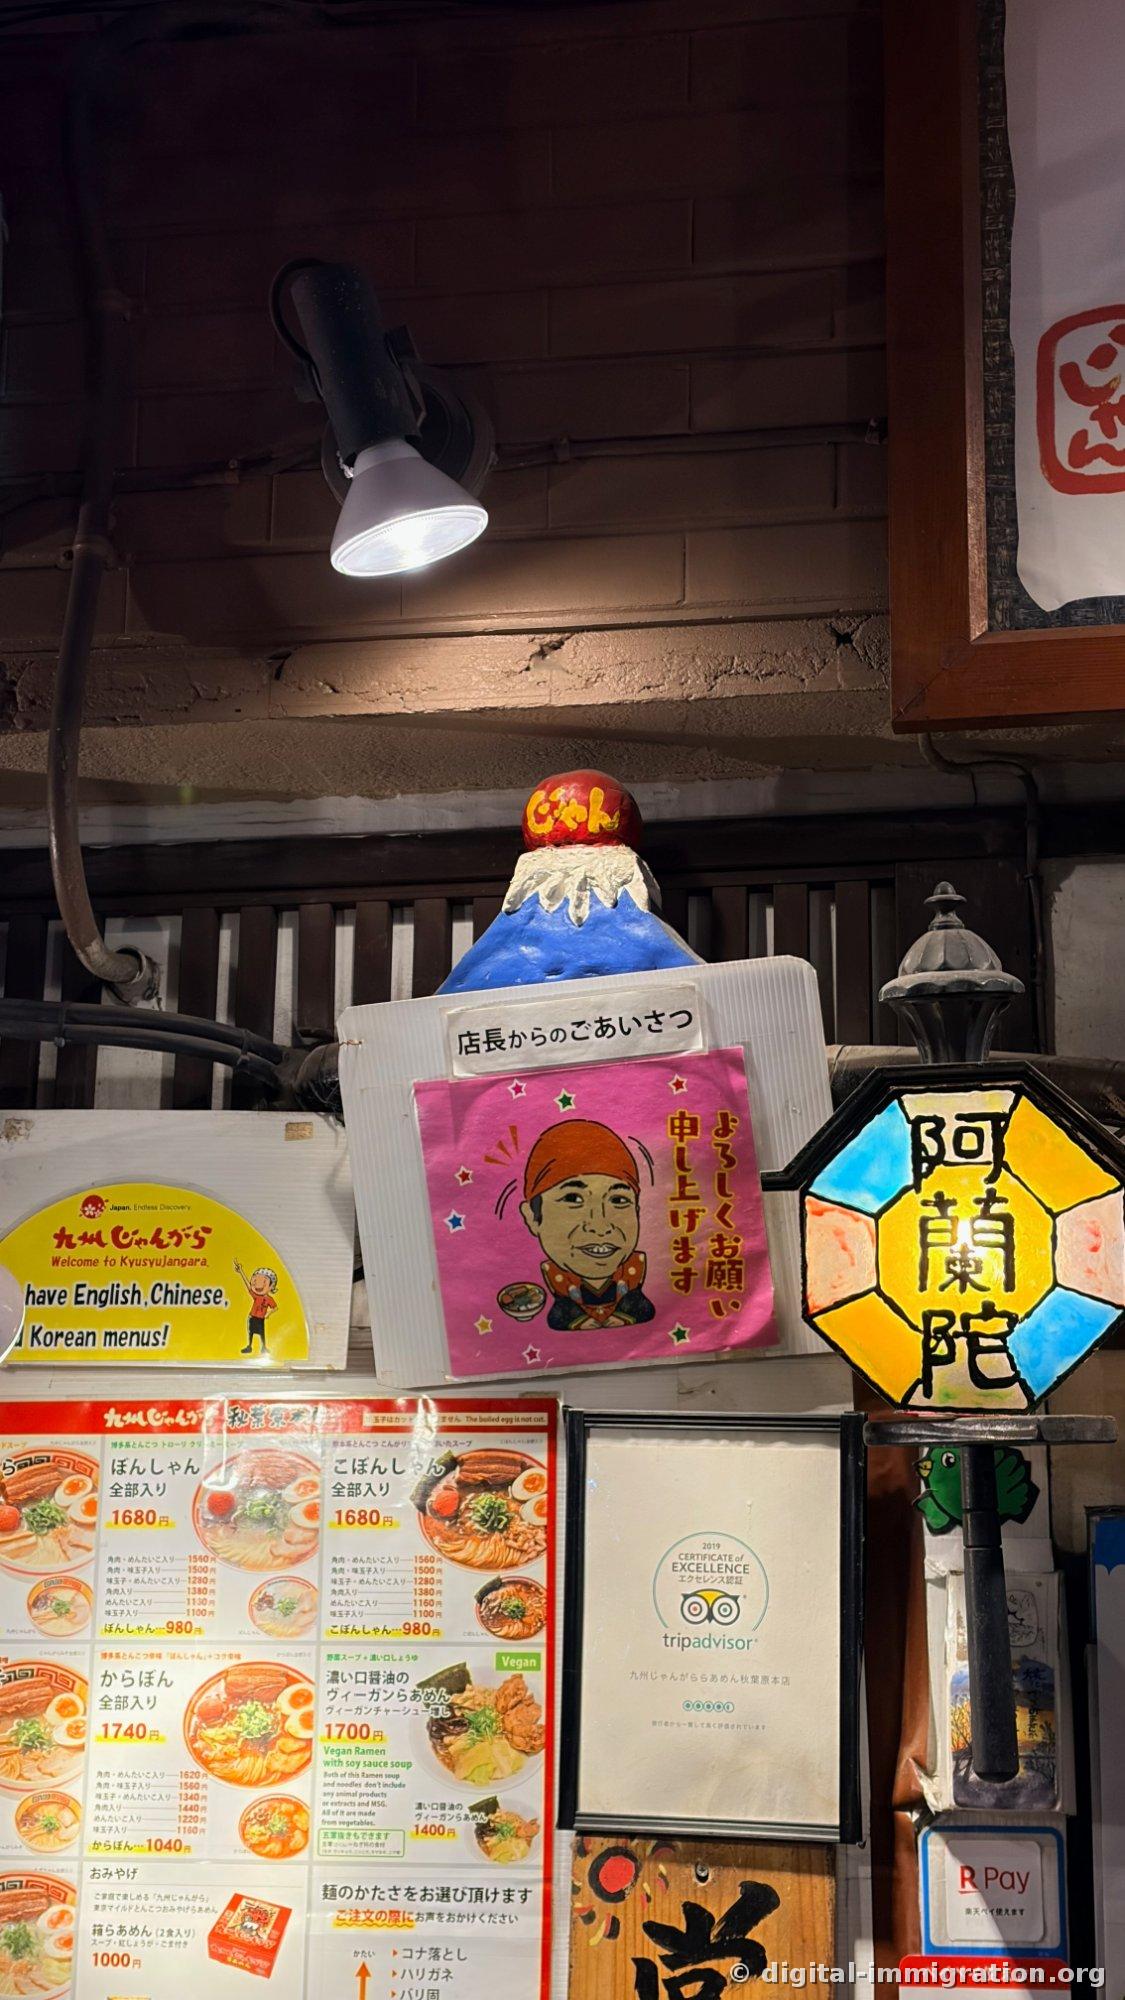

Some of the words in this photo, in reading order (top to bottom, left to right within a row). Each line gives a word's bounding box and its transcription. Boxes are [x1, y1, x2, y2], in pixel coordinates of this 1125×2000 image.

[526, 786, 621, 834] じゃん
[458, 1009, 693, 1055] 店長からのごあいさつ
[110, 1204, 131, 1212] Japan.
[668, 1110, 705, 1294] 申し上げます
[706, 1110, 745, 1319] よろしくお願い
[53, 1225, 213, 1250] 九州じゃんがら
[51, 1255, 99, 1267] Welcome
[104, 1255, 116, 1267] to
[911, 1112, 1021, 1399] 阿蘭陀
[25, 1283, 67, 1306] have
[30, 1325, 96, 1347] Korean
[103, 1325, 170, 1347] menus!
[466, 1415, 477, 1423] The
[501, 1417, 513, 1425] egg
[111, 1458, 200, 1475] ぼんしゃん
[109, 1482, 167, 1498] 全部入り
[331, 1482, 390, 1498] 全部入り
[112, 1510, 169, 1526] 1680円
[335, 1510, 393, 1526] 1680円
[678, 1553, 733, 1562] CERTIFICATE
[735, 1554, 744, 1562] of
[672, 1563, 750, 1574] EXCELLENCE
[678, 1575, 743, 1585] エクセレンス認証
[104, 1623, 155, 1633] ぼんしゃん
[330, 1624, 392, 1635] こぼんしゃん
[663, 1633, 753, 1651] tripadvisor
[501, 1656, 536, 1668] Vegan
[100, 1670, 174, 1688] からぼん
[326, 1671, 409, 1685] 濃い口醤油の
[629, 1671, 790, 1686] 九州じゃんがららあめん秋葉原本店
[99, 1695, 157, 1710] 全部入り
[326, 1688, 450, 1703] ヴィーガンらあめん
[102, 1723, 160, 1740] 1740円
[325, 1723, 383, 1741] 1700円
[324, 1746, 352, 1757] Vegan
[354, 1747, 386, 1755] Ramen
[323, 1758, 343, 1767] with
[345, 1760, 360, 1769] soy
[363, 1760, 389, 1768] sauce
[390, 1761, 413, 1770] soup
[415, 1803, 463, 1811] 濃い口醤油の
[415, 1812, 487, 1822] ヴィーガンらあめん
[414, 1824, 456, 1837] 1400円
[92, 1840, 133, 1851] からぼん
[90, 1867, 138, 1880] おみやげ
[959, 1865, 977, 1889] R
[984, 1867, 1030, 1894] Pay
[322, 1884, 532, 1904] 麺のかたさをお選び頂けます
[965, 1907, 1025, 1916] 楽天ペイ使えます
[92, 1924, 152, 1937] 箱らあめん
[92, 1952, 141, 1968] 1000円
[353, 1950, 375, 1958] かたい
[402, 1948, 468, 1961] コナ落とし
[400, 1968, 454, 1981] ハリガネ
